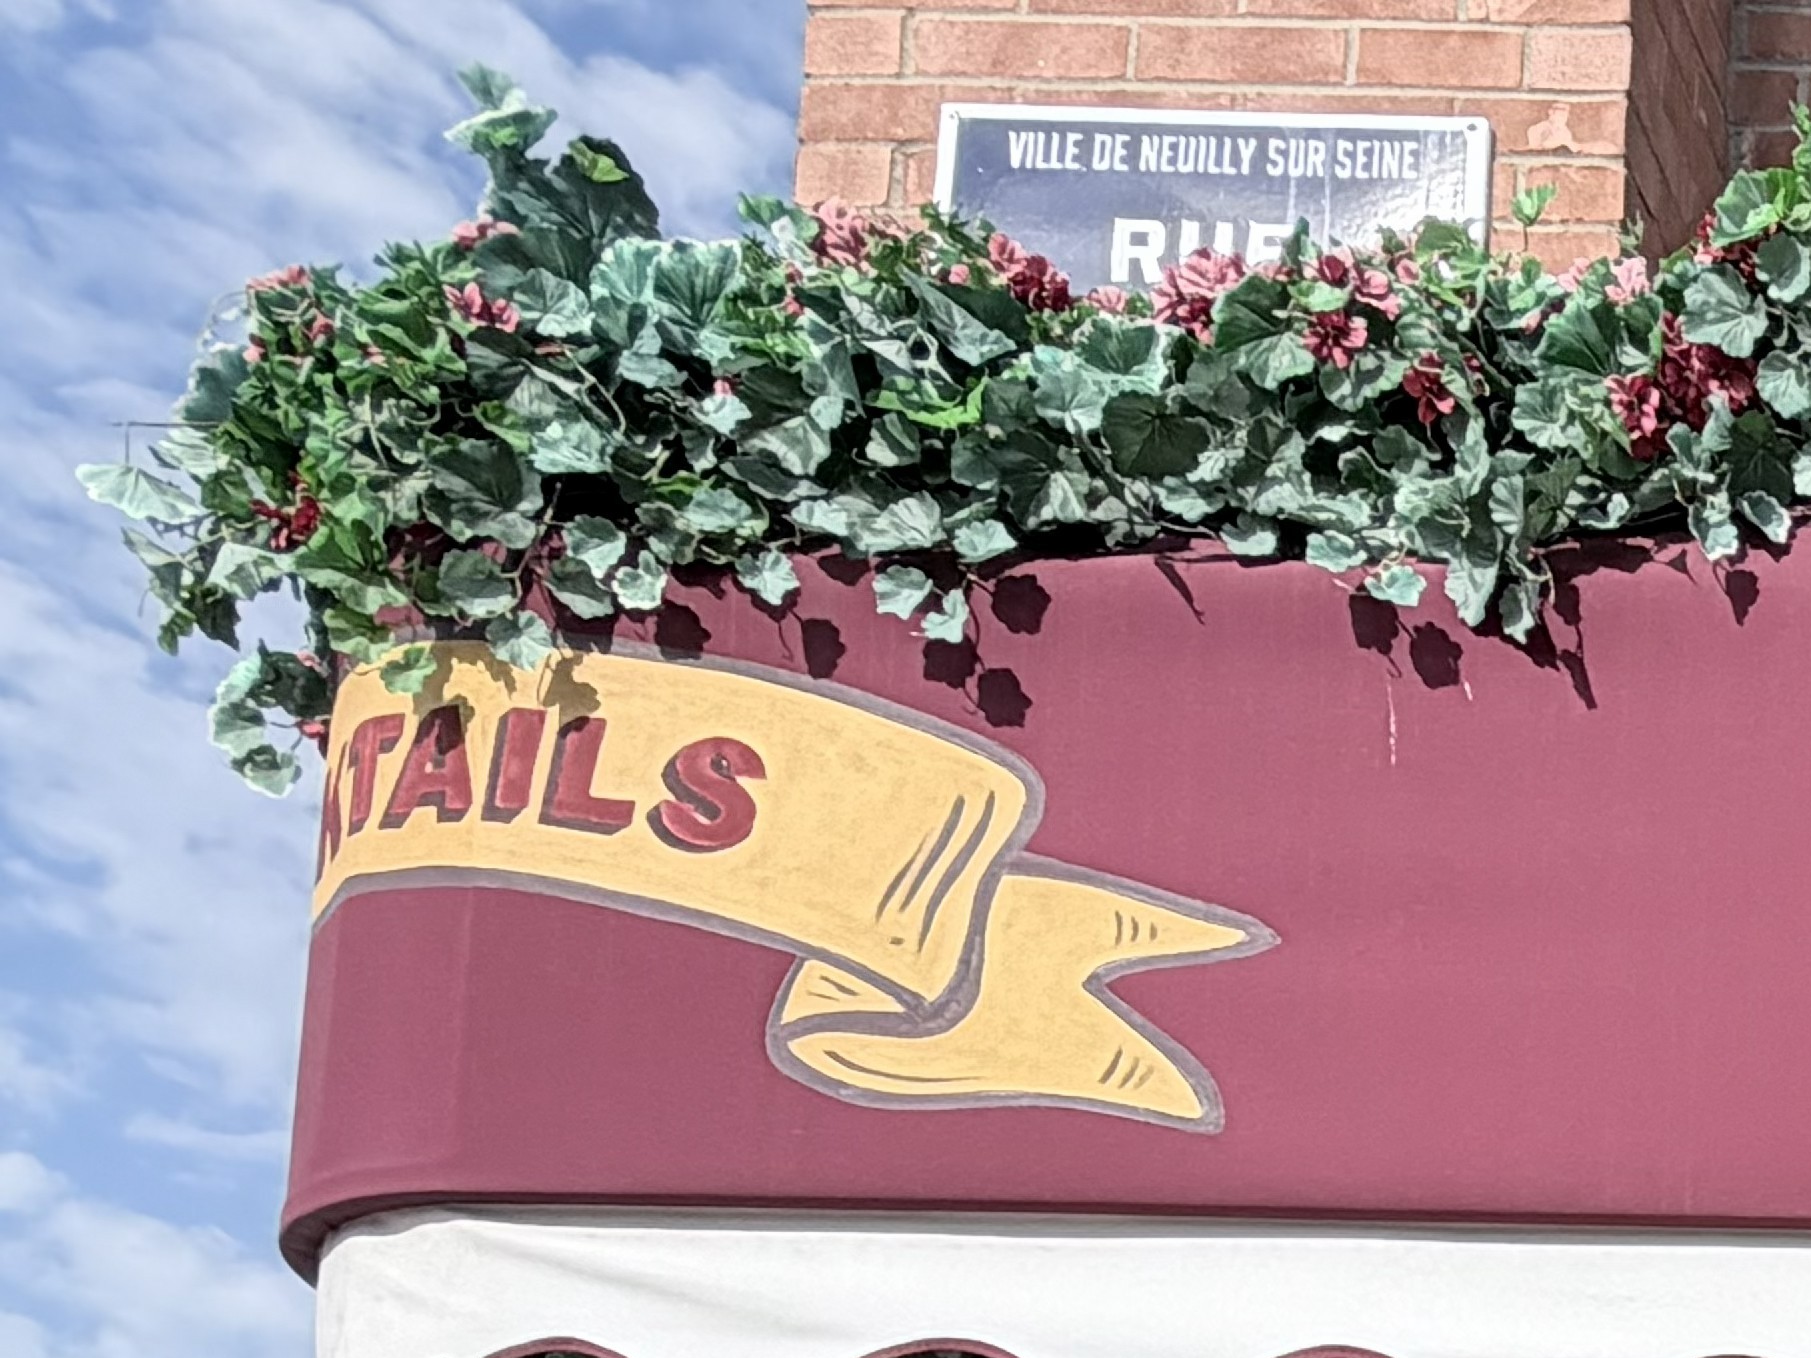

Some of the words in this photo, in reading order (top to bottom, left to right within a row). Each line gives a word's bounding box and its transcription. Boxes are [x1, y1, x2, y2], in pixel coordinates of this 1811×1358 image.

[1008, 131, 1082, 169] VILLE
[1092, 133, 1131, 171] DE
[1139, 135, 1257, 175] NEUILLY
[1266, 138, 1326, 178] SUR
[1334, 139, 1418, 179] SEINE
